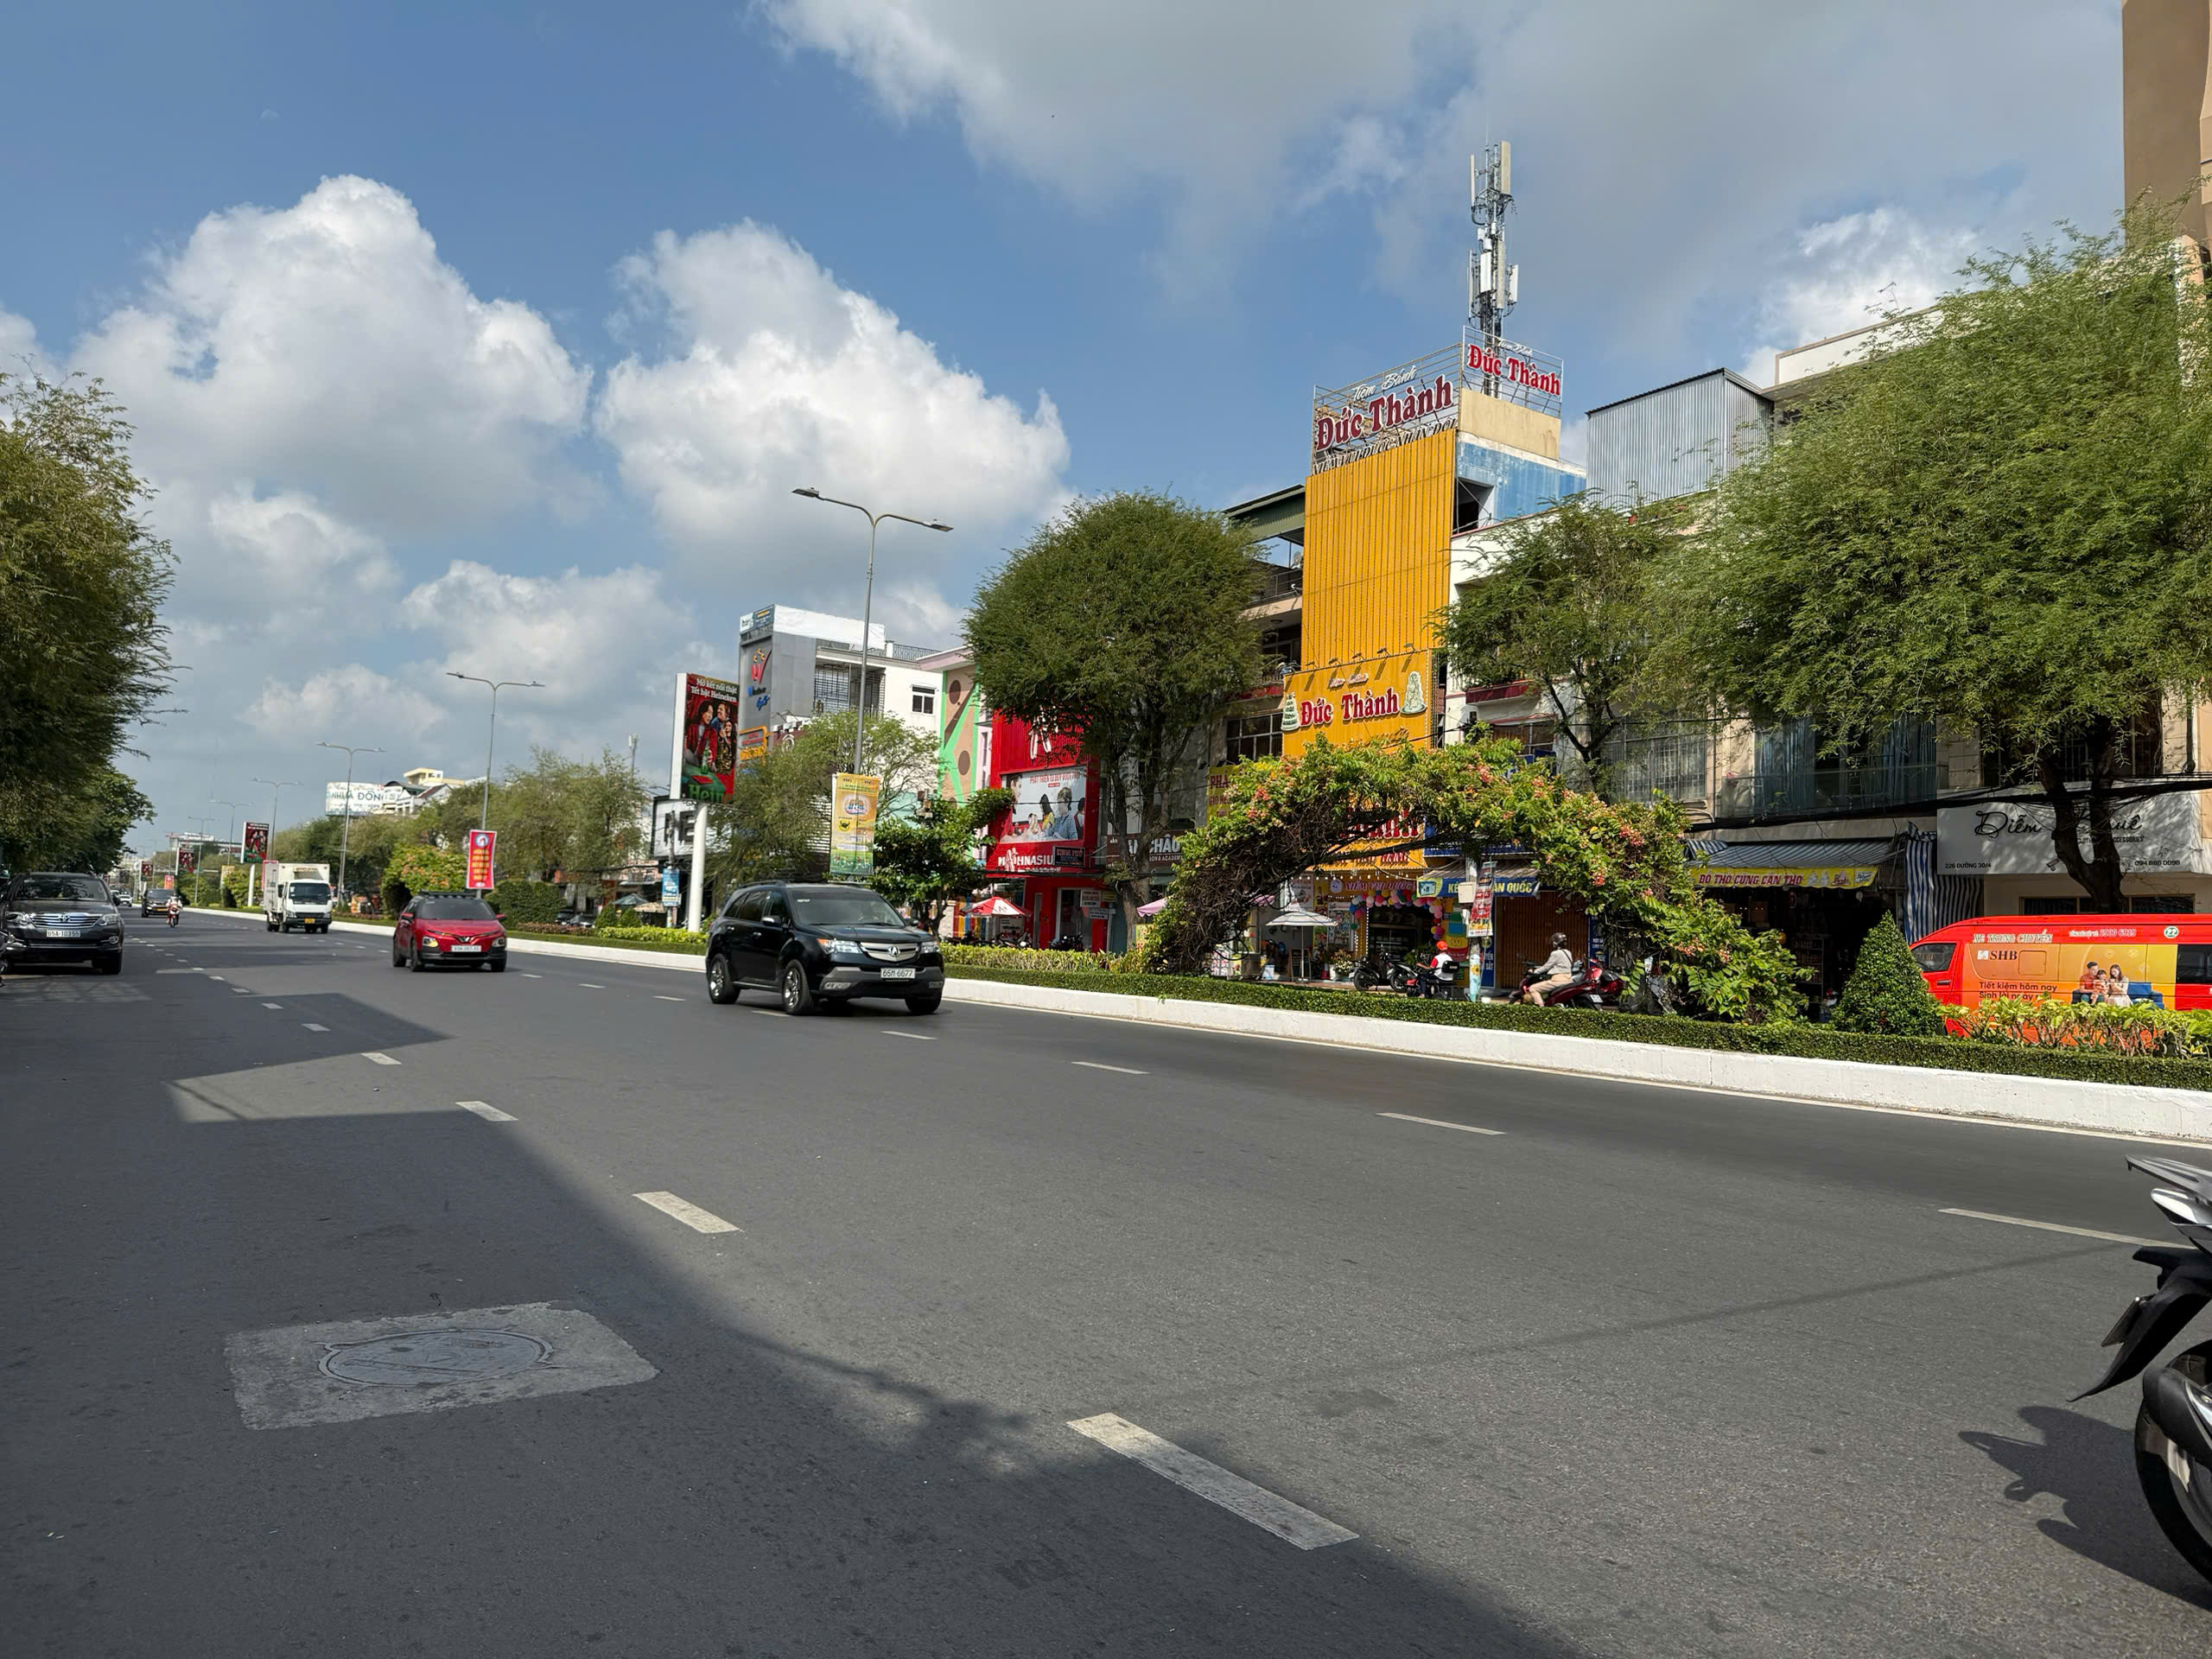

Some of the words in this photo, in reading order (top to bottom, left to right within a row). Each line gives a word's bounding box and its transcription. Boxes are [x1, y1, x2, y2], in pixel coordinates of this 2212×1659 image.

[1382, 365, 1418, 391] Bánh
[1467, 344, 1503, 377] Đức
[1506, 356, 1561, 397] Thành
[1315, 405, 1364, 452] Đức
[1368, 373, 1455, 434] Thành
[1300, 697, 1334, 727] Đức
[1341, 687, 1400, 721] Thành
[1974, 810, 2043, 838] Diễm
[997, 848, 1054, 873] MATHNASIU
[1506, 879, 1533, 894] QUỐC
[2166, 928, 2178, 937] 22
[1989, 950, 2018, 961] SHB
[1979, 990, 1997, 999] Sinh
[1980, 981, 1995, 989] Tiết
[1997, 982, 2018, 991] kiệm
[2019, 982, 2038, 990] hôm
